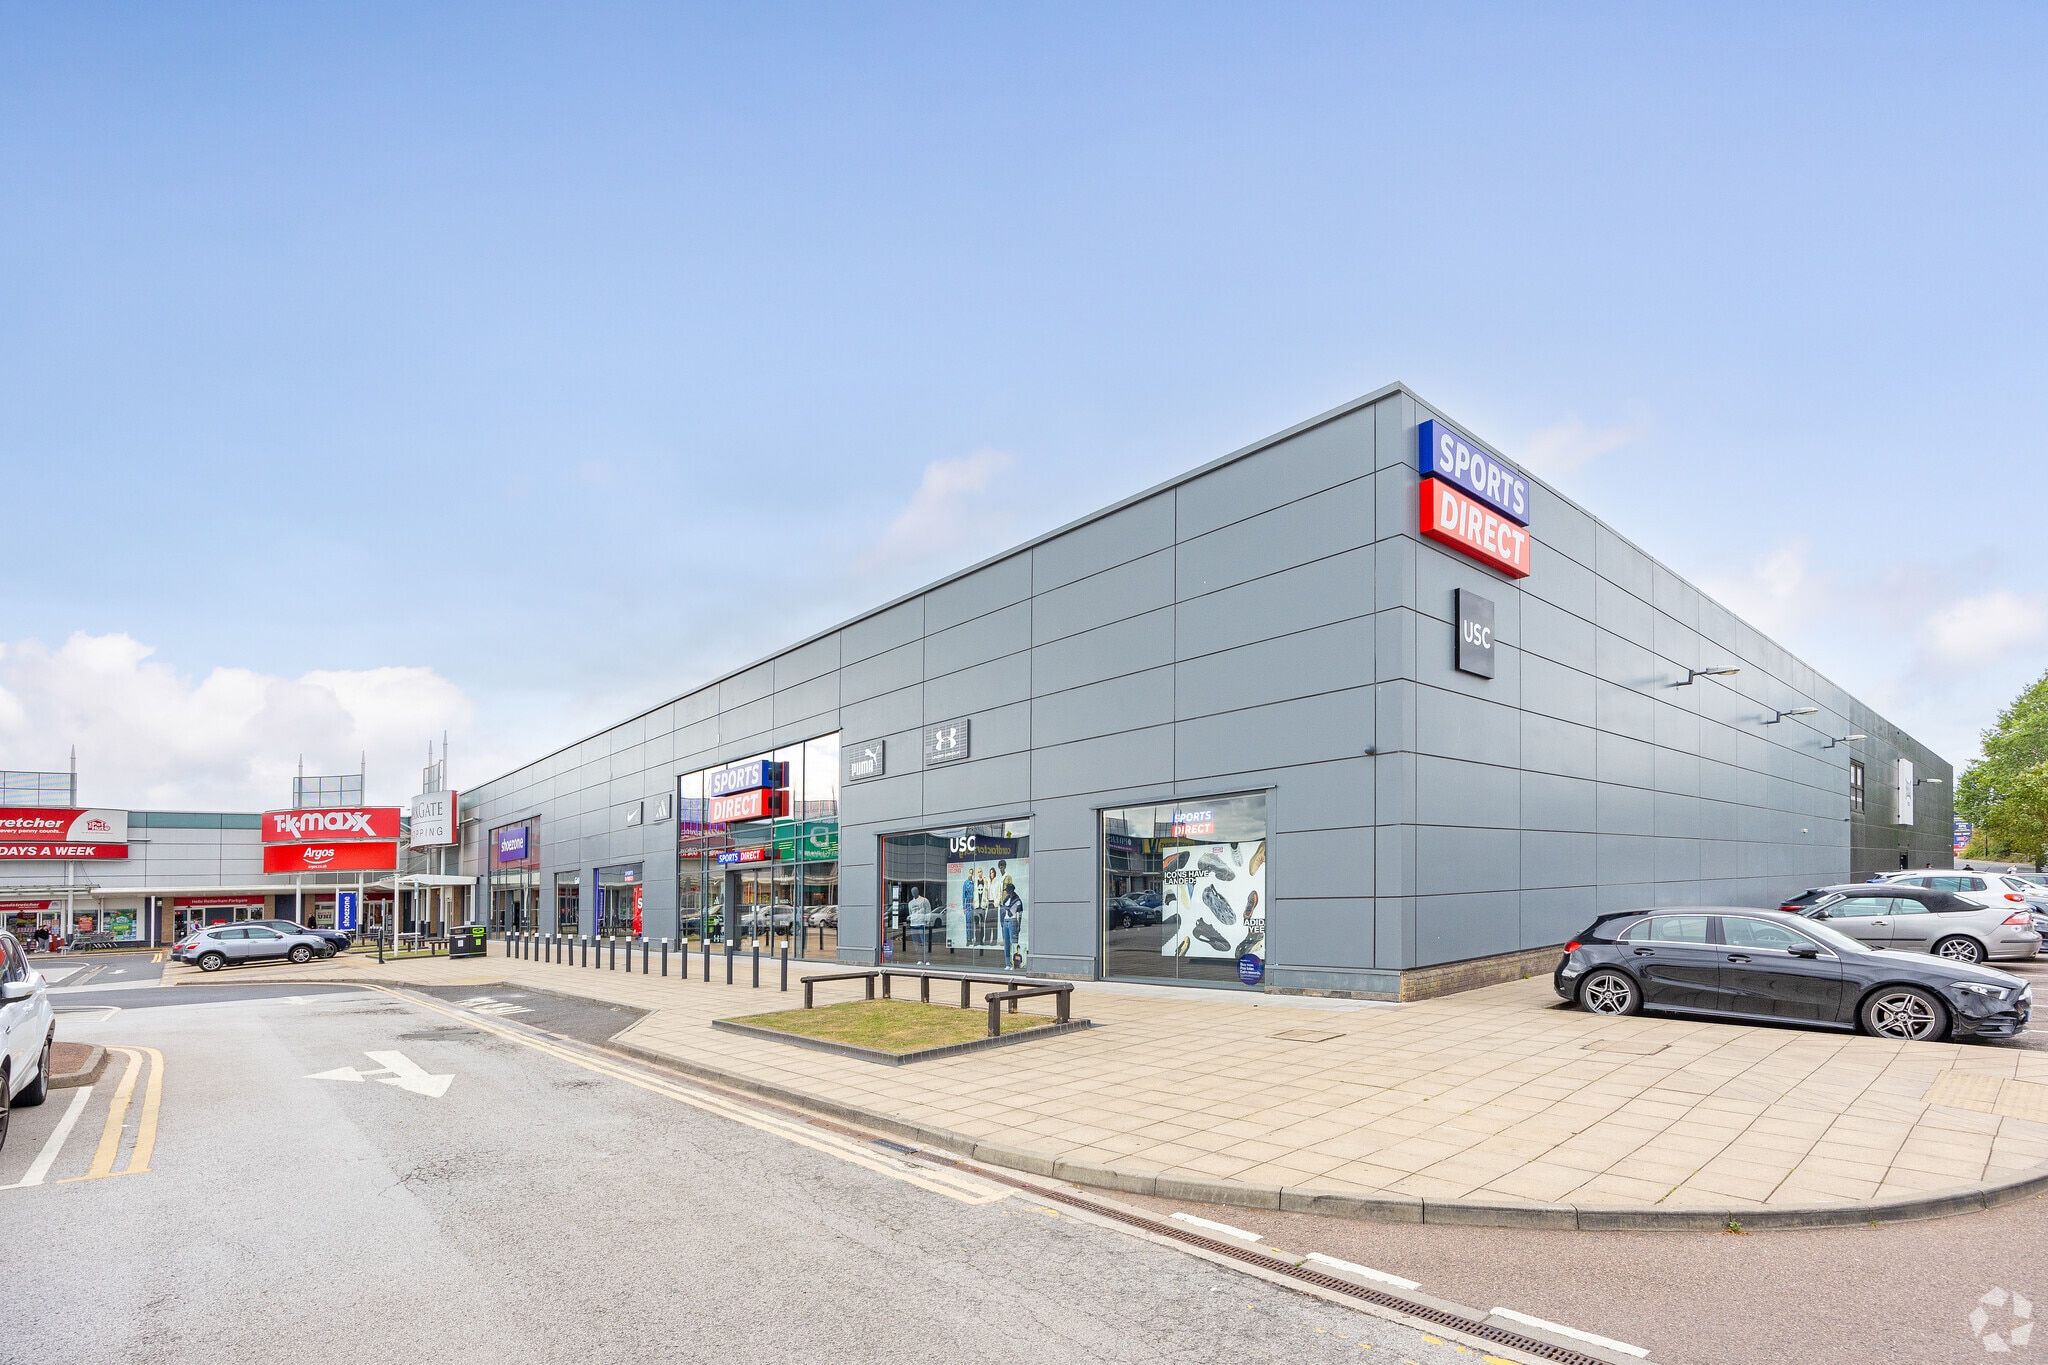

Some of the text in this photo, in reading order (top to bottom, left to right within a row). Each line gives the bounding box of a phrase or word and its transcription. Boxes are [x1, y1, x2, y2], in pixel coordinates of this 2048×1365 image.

[1440, 433, 1525, 515] SPORTS
[1440, 490, 1525, 566] DIRECT
[1464, 620, 1491, 649] USC
[851, 759, 874, 777] PUMA
[713, 763, 760, 794] SPORTS
[713, 793, 759, 821] DIRECT
[1174, 810, 1212, 823] SPORTS
[1174, 823, 1211, 837] DIRECT
[40, 847, 52, 856] A
[55, 846, 96, 856] WEEK
[501, 837, 524, 853] shoezone
[950, 835, 977, 853] USC
[303, 847, 335, 860] Argos
[719, 852, 739, 863] SPORTS
[740, 850, 761, 861] DIRECT
[1164, 870, 1209, 879] ICONS HAVE
[343, 896, 351, 928] shoezone
